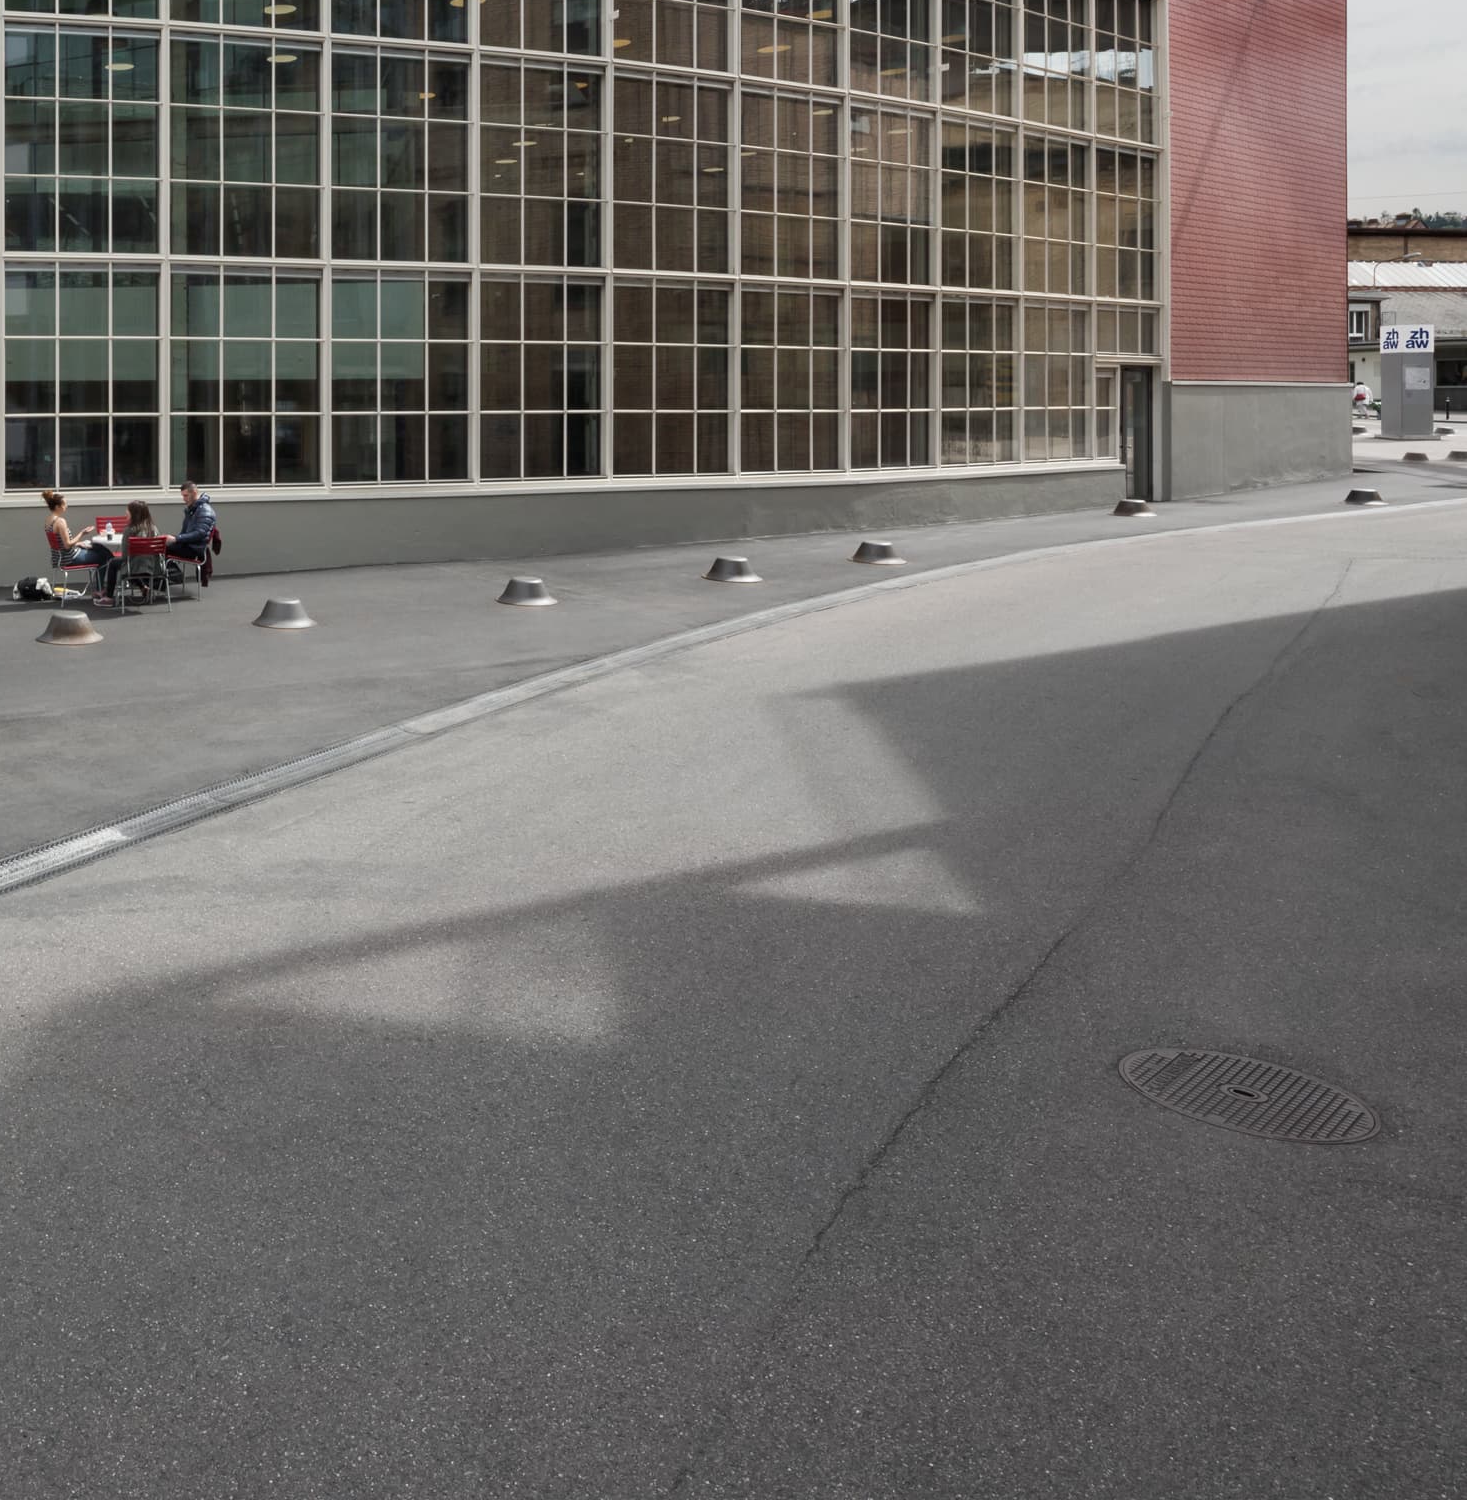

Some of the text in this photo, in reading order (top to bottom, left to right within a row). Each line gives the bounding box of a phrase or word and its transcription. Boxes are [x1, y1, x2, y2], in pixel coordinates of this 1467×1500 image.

[1386, 328, 1399, 340] zh
[1410, 327, 1429, 340] zh
[1383, 340, 1399, 349] aw
[1405, 340, 1429, 349] aw
